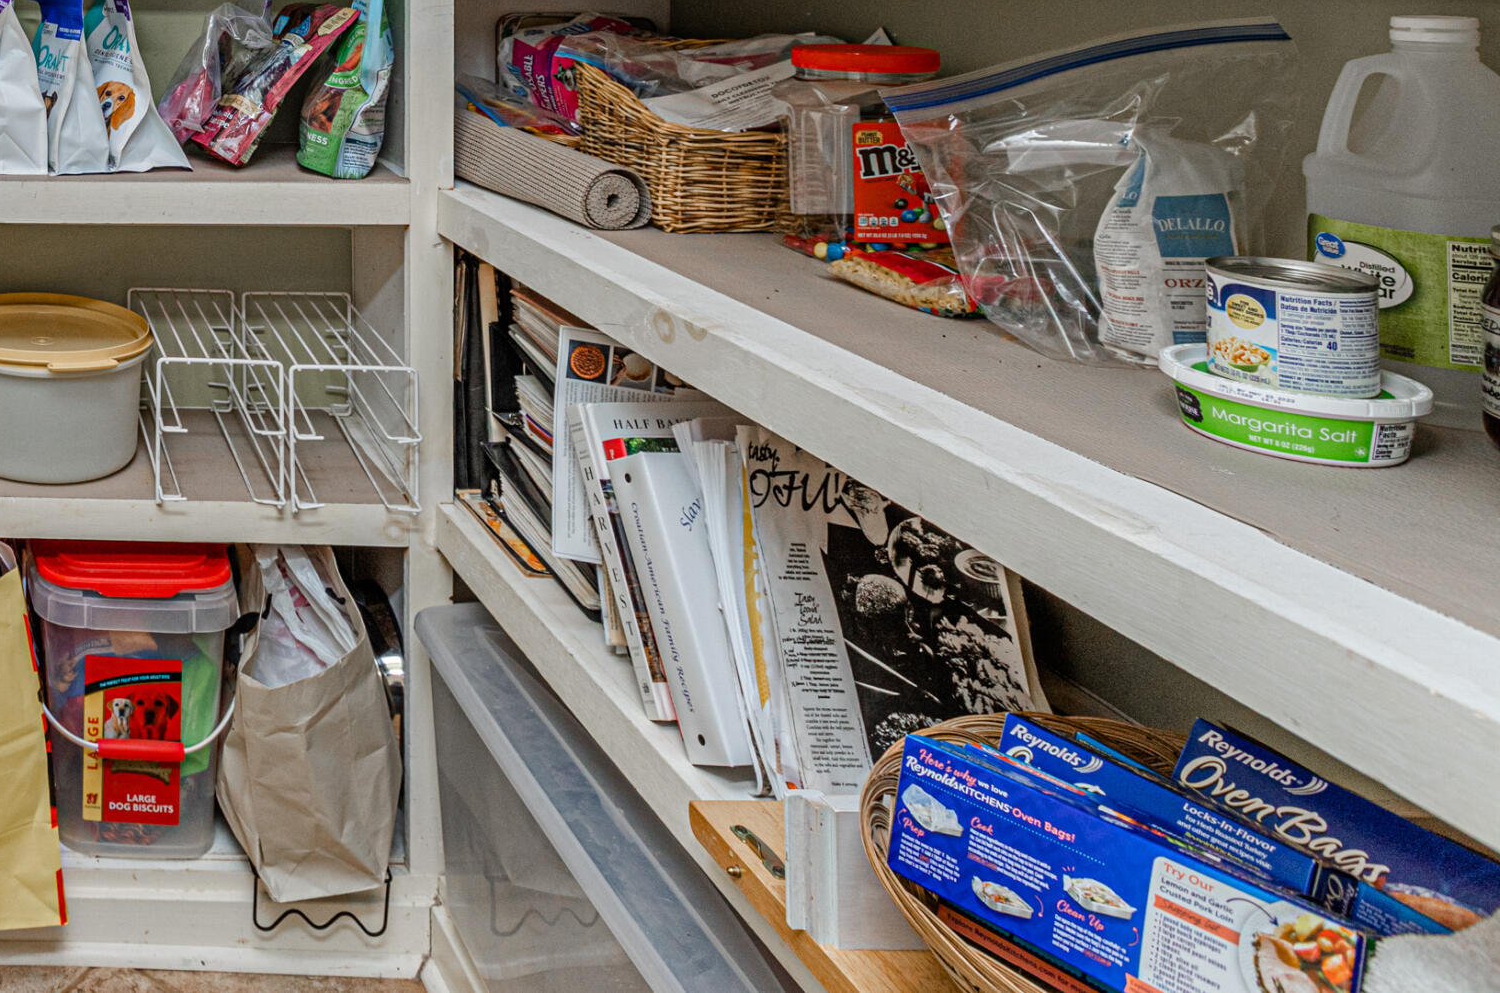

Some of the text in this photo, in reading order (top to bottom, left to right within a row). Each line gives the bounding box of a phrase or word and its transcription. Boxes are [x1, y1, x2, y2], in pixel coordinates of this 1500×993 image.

[1157, 217, 1226, 233] DELALLO
[1318, 236, 1340, 255] Great Value
[1359, 261, 1396, 273] Distilled
[1164, 278, 1206, 289] ORZ
[1280, 295, 1333, 307] Nutrition Facts
[1280, 303, 1338, 315] Datos Nutrición
[1327, 341, 1338, 351] 40
[613, 418, 651, 430] HALF
[1211, 405, 1357, 444] Margarita Salt
[1248, 434, 1262, 443] NET
[1263, 437, 1274, 445] WT
[1379, 431, 1396, 439] Facts
[583, 465, 635, 637] HARVEST
[662, 616, 680, 664] Family
[676, 665, 695, 713] Recipes
[87, 716, 100, 771] LAGE
[1010, 722, 1083, 767] Reynolds
[1198, 729, 1298, 786] Reynolds
[919, 748, 1008, 799] Here's why we love
[108, 801, 174, 814] DOG BISCUITS
[126, 794, 157, 803] LARGE
[902, 816, 925, 838] Prep
[970, 816, 993, 836] Cook
[1012, 808, 1076, 843] Oven Bags!
[1179, 755, 1391, 884] Oven Bags
[1192, 825, 1210, 838] other
[1210, 833, 1229, 849] great
[1229, 842, 1254, 861] recipes
[1196, 819, 1268, 859] Herb Roasted Turkey
[1164, 862, 1215, 893] Try Our
[1160, 885, 1234, 924] Crusted Pork Loin
[1161, 877, 1234, 915] Lemon and Garlic
[1056, 899, 1105, 931] Clean Up
